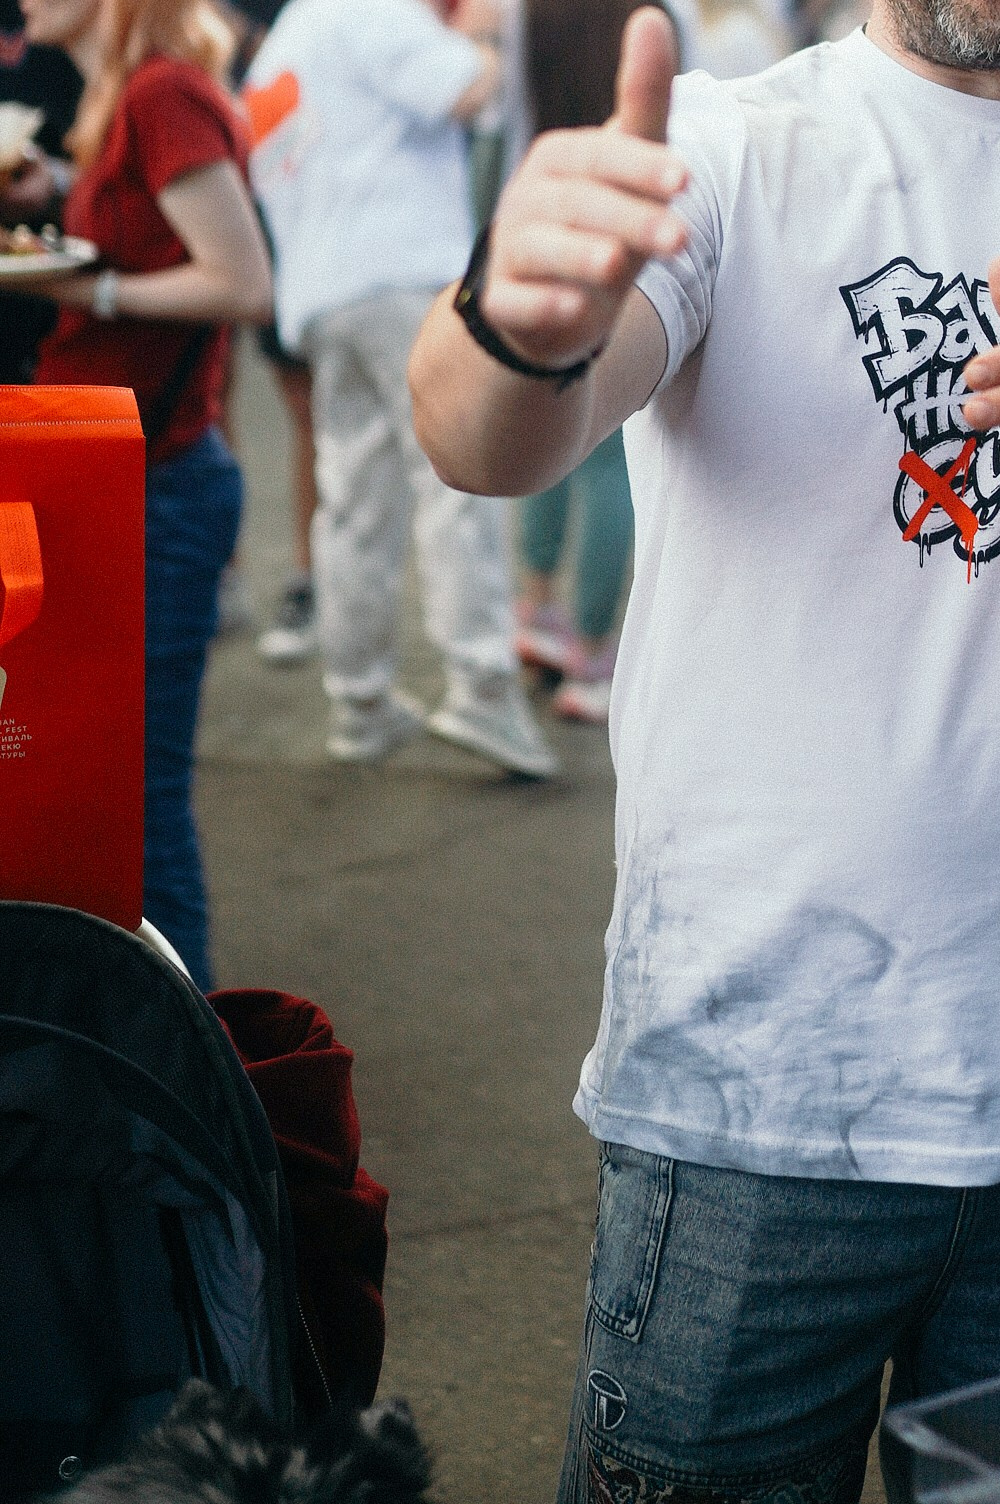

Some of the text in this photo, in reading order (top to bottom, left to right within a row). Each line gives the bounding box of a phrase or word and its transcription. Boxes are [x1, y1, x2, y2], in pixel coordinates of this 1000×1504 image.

[0, 718, 15, 726] AN
[0, 734, 32, 742] ИВАЛЬ
[0, 751, 26, 759] ТУРЫ
